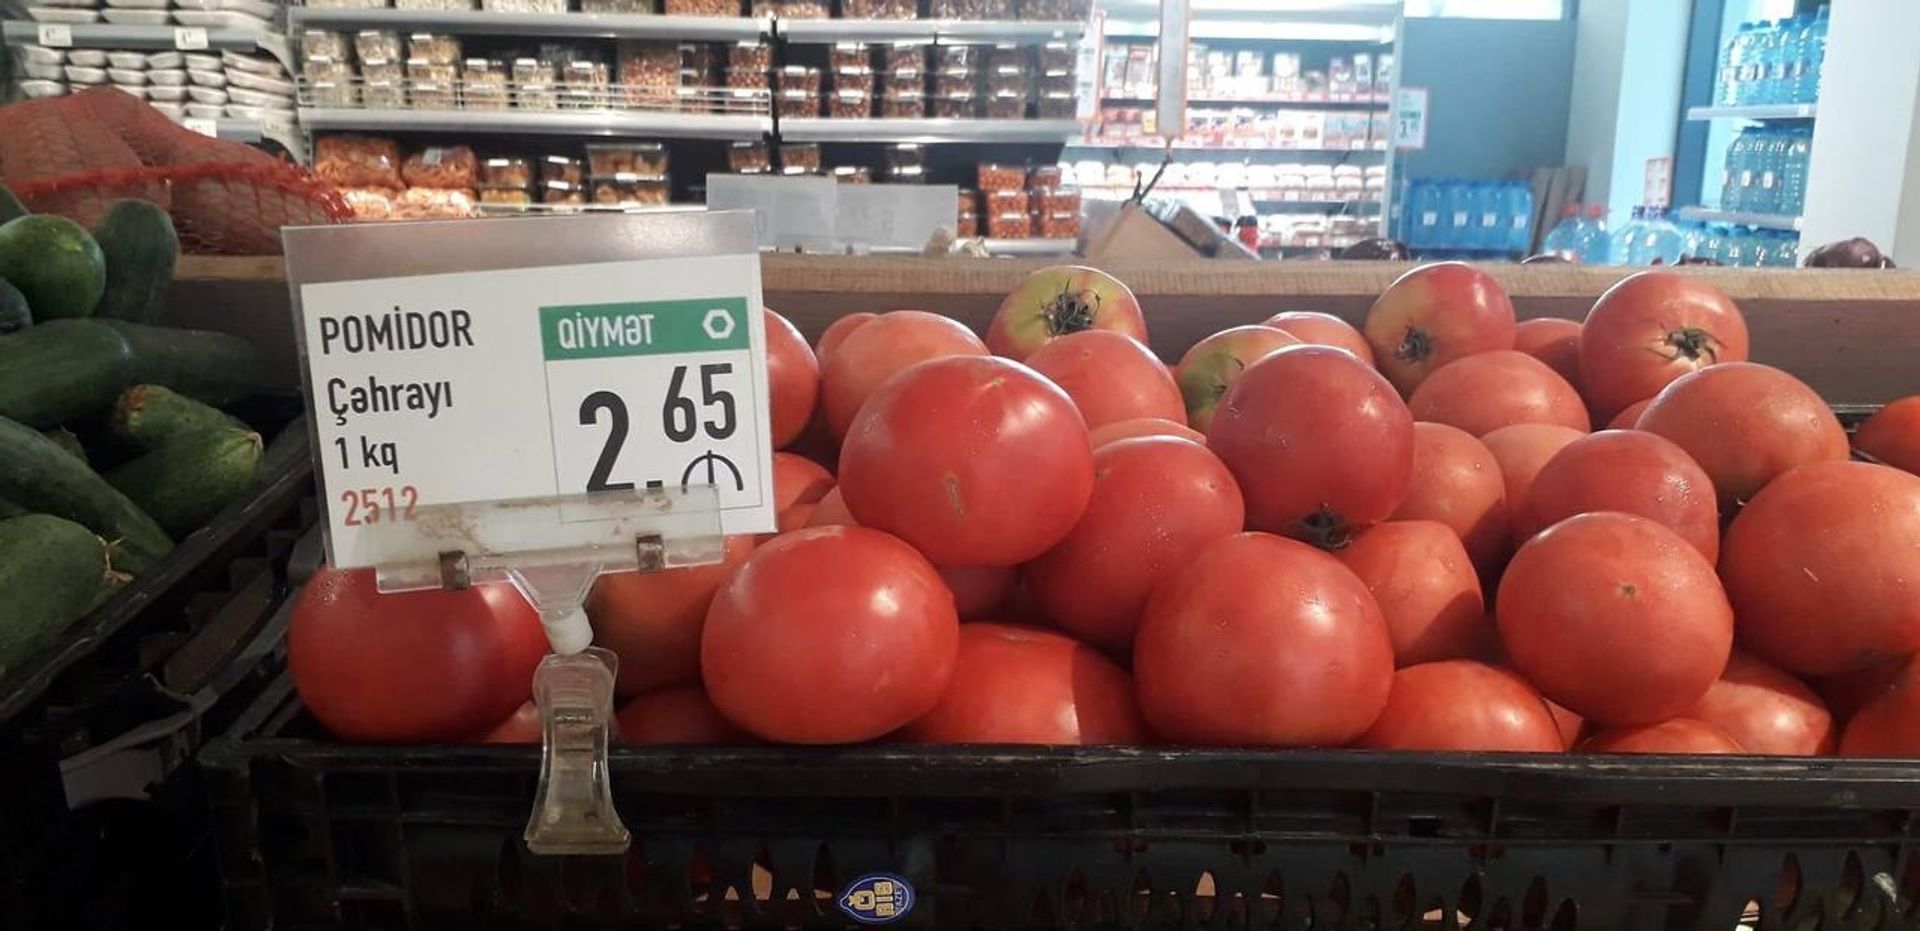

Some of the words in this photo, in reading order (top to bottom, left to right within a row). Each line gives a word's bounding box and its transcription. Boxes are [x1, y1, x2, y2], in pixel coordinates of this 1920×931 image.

[319, 305, 474, 354] POMİDOR
[557, 311, 655, 350] QİYMƏT
[327, 375, 453, 427] Çəhrayı
[334, 436, 349, 470] 1
[360, 435, 399, 475] kq
[342, 485, 418, 527] 2512
